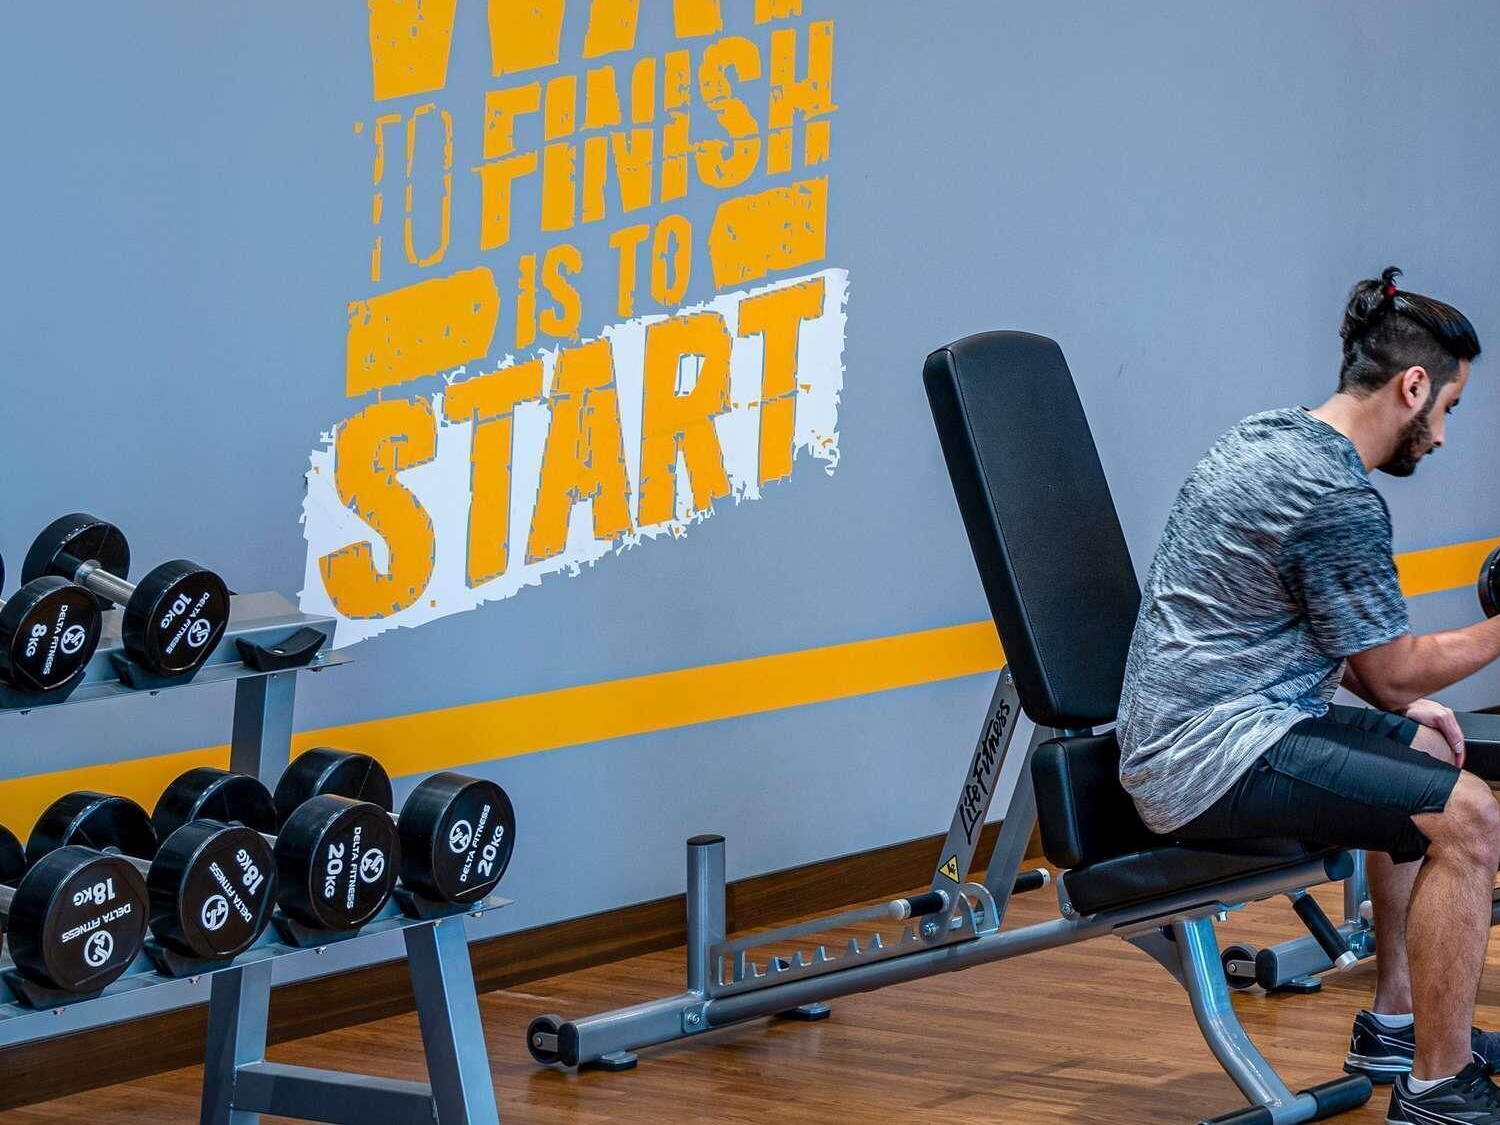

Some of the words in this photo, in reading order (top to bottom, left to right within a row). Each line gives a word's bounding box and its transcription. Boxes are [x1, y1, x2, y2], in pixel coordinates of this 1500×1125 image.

[354, 103, 453, 283] TO
[475, 20, 838, 252] FINISH
[516, 244, 584, 349] IS
[609, 215, 693, 317] TO
[318, 275, 826, 621] START
[53, 604, 69, 634] DELTA
[160, 593, 193, 629] 10KG
[190, 592, 210, 618] DELTA
[25, 623, 48, 657] 8KG
[165, 618, 192, 654] FITNESS
[42, 636, 59, 675] FITNESS
[351, 826, 362, 861] DELTA
[459, 850, 476, 882] DELTA
[472, 804, 491, 848] FITNESS
[477, 825, 504, 877] 20KG
[208, 861, 236, 897] FITNESS
[236, 848, 264, 895] 18KG
[324, 842, 345, 898] 20KG
[346, 863, 358, 909] FITNESS
[73, 878, 116, 906] 18KG
[232, 894, 253, 923] DELTA
[61, 917, 101, 943] FITNESS
[102, 903, 132, 924] DELTA
